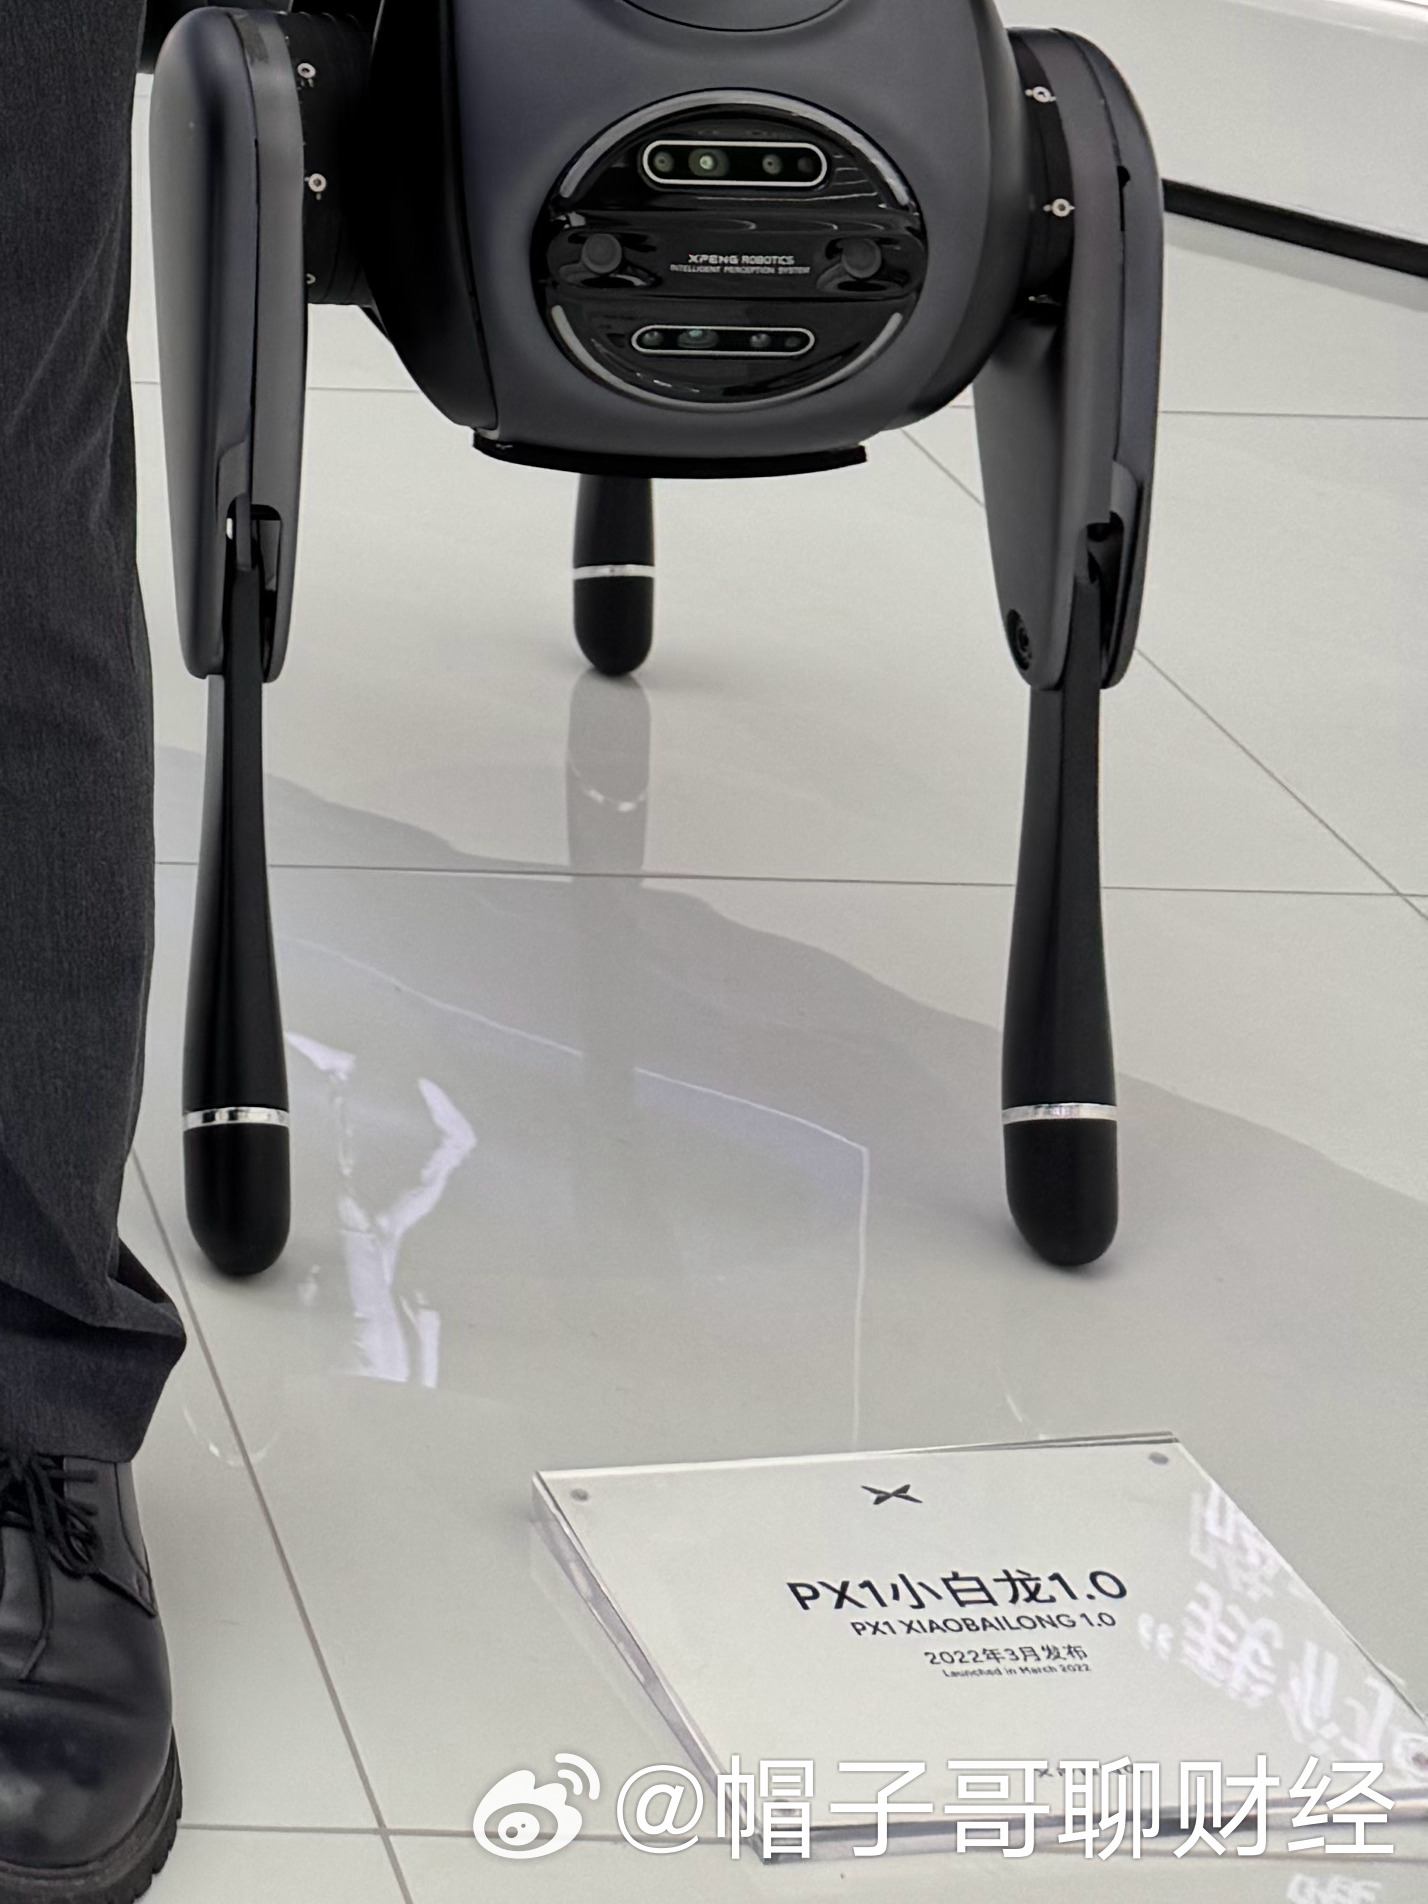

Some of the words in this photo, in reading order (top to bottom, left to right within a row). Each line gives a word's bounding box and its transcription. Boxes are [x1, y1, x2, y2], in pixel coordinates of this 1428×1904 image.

[688, 254, 739, 264] XPENG
[741, 255, 795, 265] ROBOTICS
[787, 1569, 1128, 1610] PX1小白龙1.0
[850, 1620, 895, 1636] PX1
[897, 1613, 1076, 1635] XIAOBAILONG
[1080, 1612, 1116, 1628] 1.0
[924, 1644, 1088, 1664] 2022年3月发布
[942, 1667, 1003, 1677] Launched
[1005, 1666, 1017, 1675] in
[1019, 1664, 1057, 1675] March
[1059, 1663, 1091, 1673] 2022
